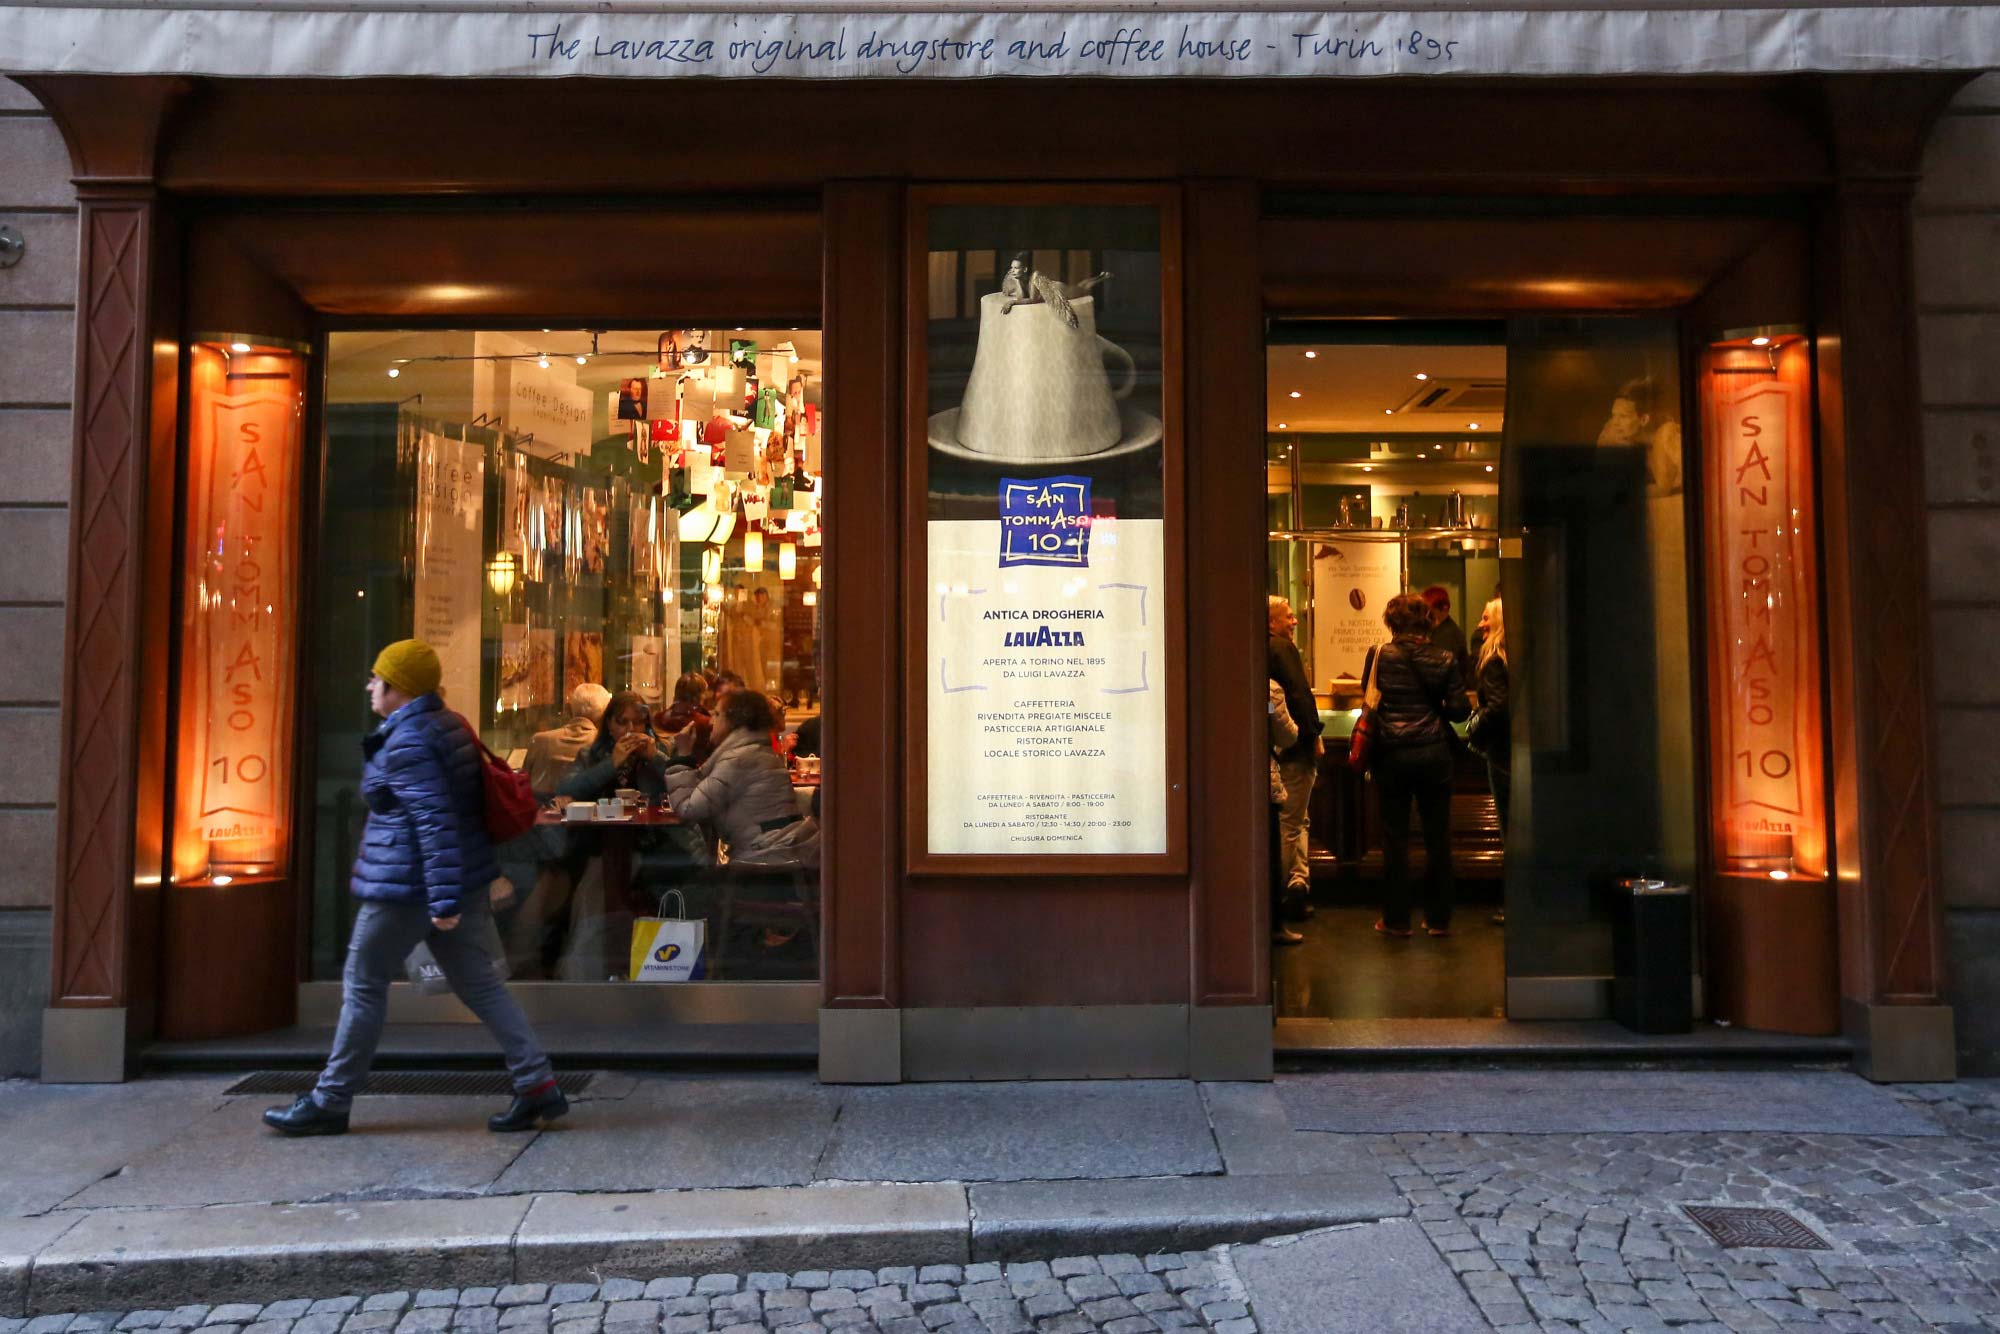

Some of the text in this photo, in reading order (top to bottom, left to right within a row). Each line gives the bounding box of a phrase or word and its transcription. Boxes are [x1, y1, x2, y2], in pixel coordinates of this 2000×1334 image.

[528, 24, 580, 60] The
[595, 35, 714, 63] Lavazza
[729, 27, 847, 74] original
[857, 28, 994, 74] drugstore
[1008, 32, 1070, 60] and
[1080, 28, 1165, 66] coffee
[1178, 25, 1252, 60] house
[1292, 28, 1383, 60] Turin
[1397, 30, 1459, 61] 1895
[1736, 415, 1771, 508] SAN
[1026, 487, 1064, 509] SAN
[1003, 508, 1089, 529] TOMMASO
[1029, 533, 1061, 551] 10
[983, 610, 1104, 620] ANTICA DROGHERIA
[1004, 625, 1085, 647] LAVAZZA
[983, 658, 1018, 666] APERTA
[1003, 670, 1085, 678] DA LUIGI LAVAZZA
[1014, 700, 1075, 708] CAFFETTERIA
[978, 712, 1112, 720] RIVENDITA PREGIATE MISCELE
[984, 725, 1042, 733] PASTICCERIA
[1016, 737, 1073, 745] RISTORANTE
[984, 749, 1106, 757] LOCALE STORICO LAVAZZA
[212, 754, 267, 785] 10
[1737, 750, 1791, 779] 10
[1046, 834, 1083, 842] DOMENICA
